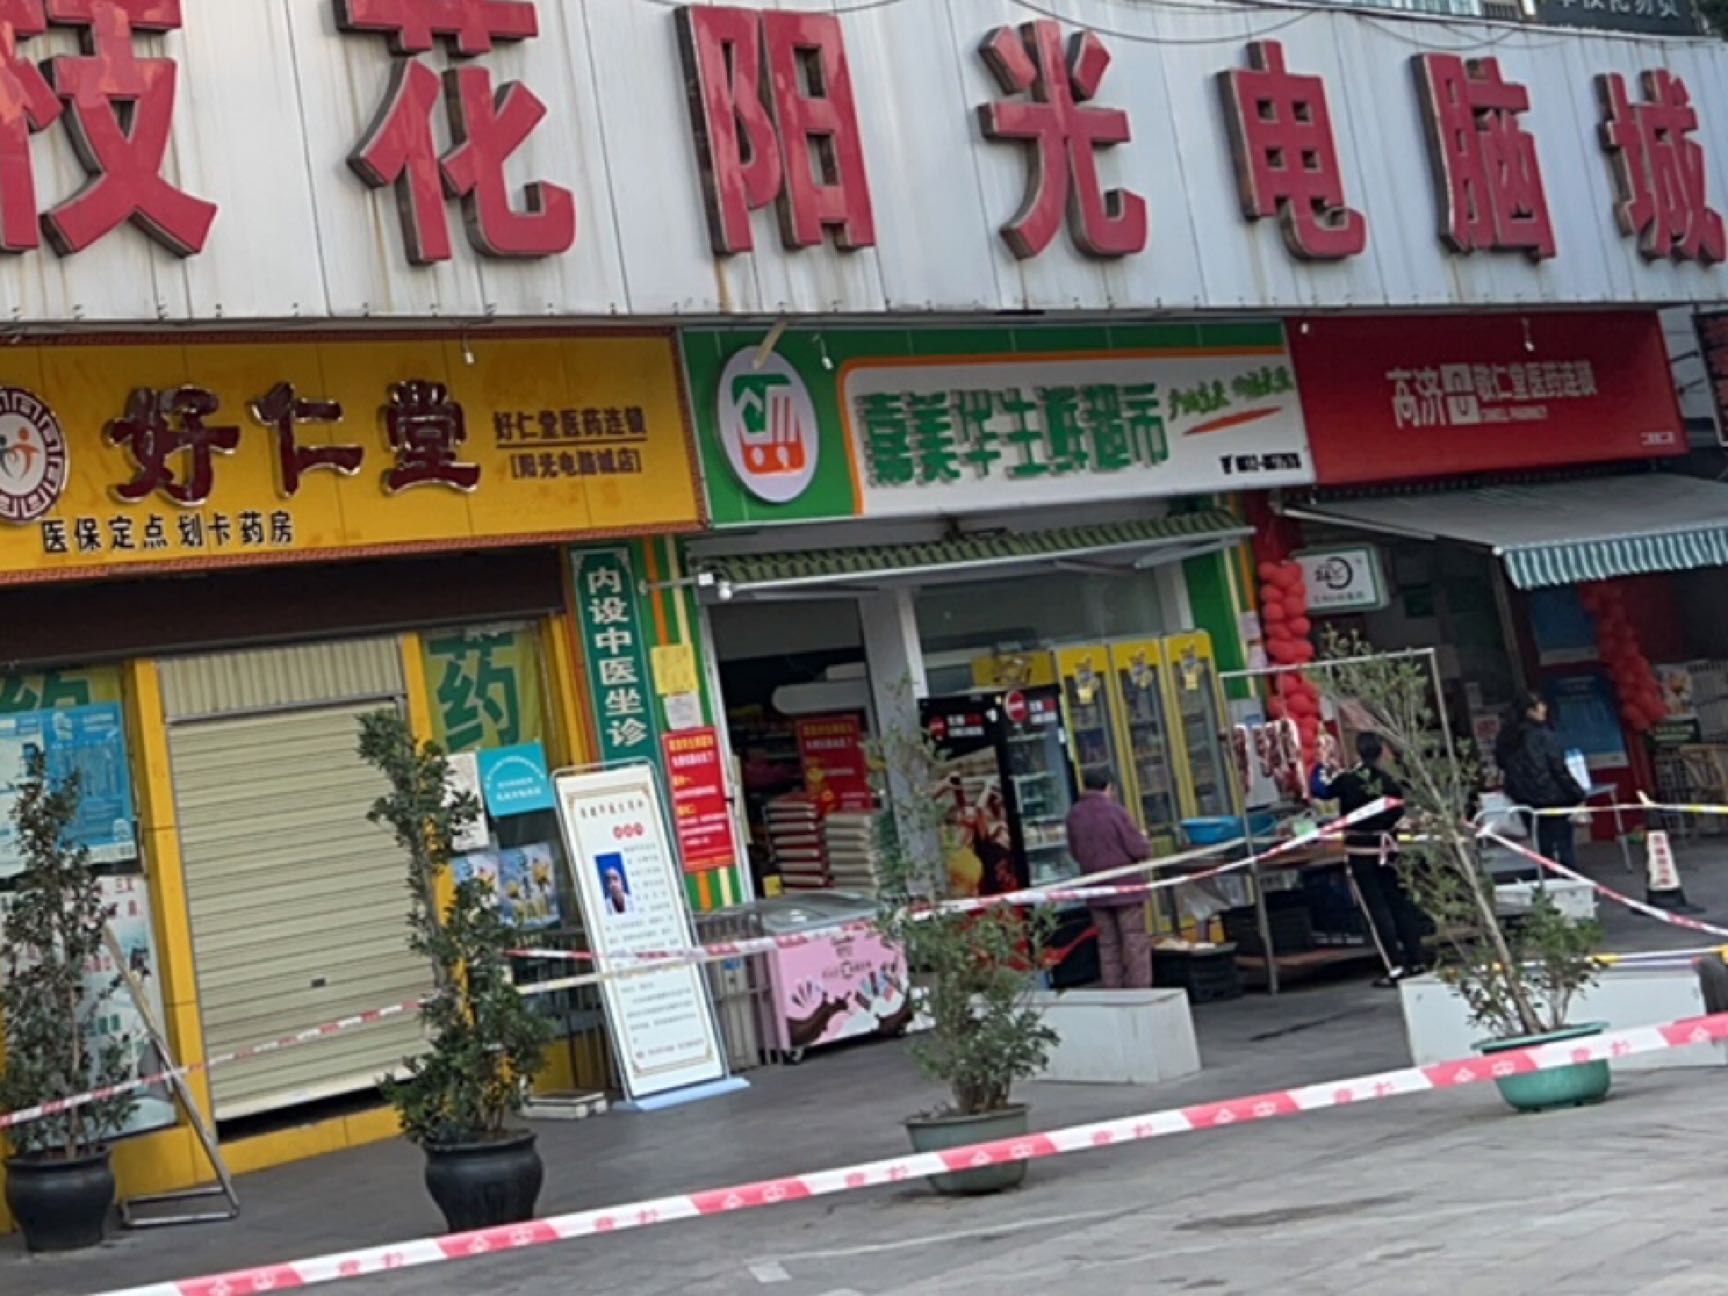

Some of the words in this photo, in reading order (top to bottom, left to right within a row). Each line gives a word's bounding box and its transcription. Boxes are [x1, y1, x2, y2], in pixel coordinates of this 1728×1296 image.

[104, 378, 481, 506] 好仁堂
[587, 566, 650, 749] 内设中医坐诊
